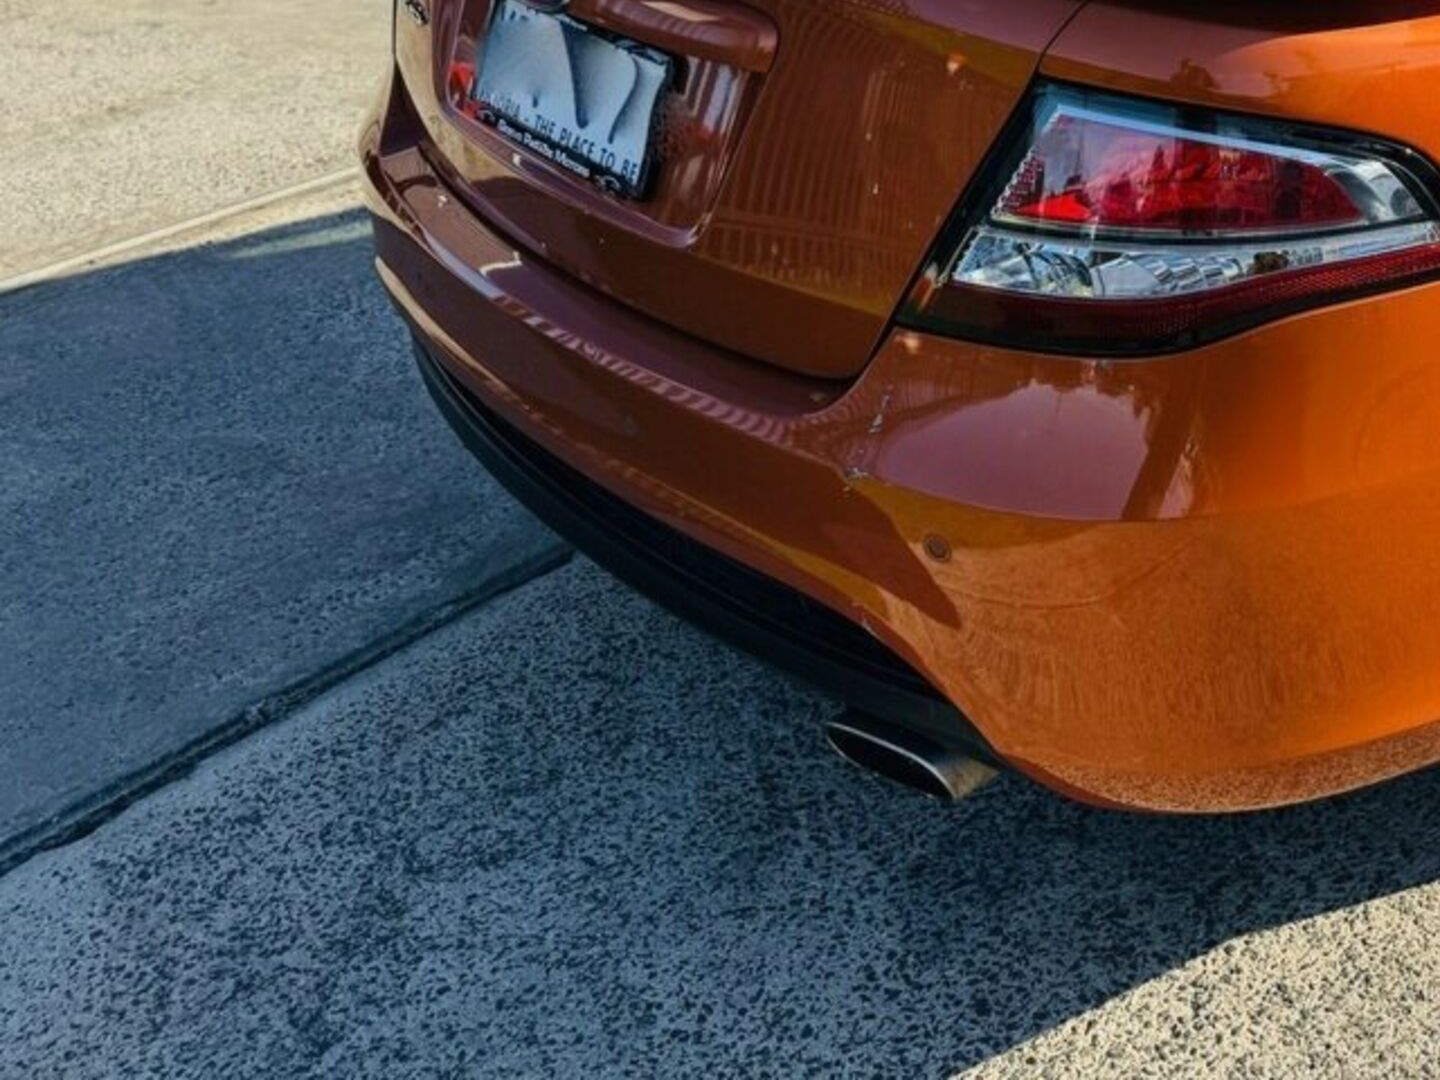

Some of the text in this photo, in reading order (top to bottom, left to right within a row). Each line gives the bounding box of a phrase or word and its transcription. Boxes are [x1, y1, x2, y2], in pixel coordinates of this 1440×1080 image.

[536, 114, 556, 135] THE
[561, 127, 595, 156] PLACE
[601, 148, 615, 169] TO
[622, 159, 638, 184] BE
